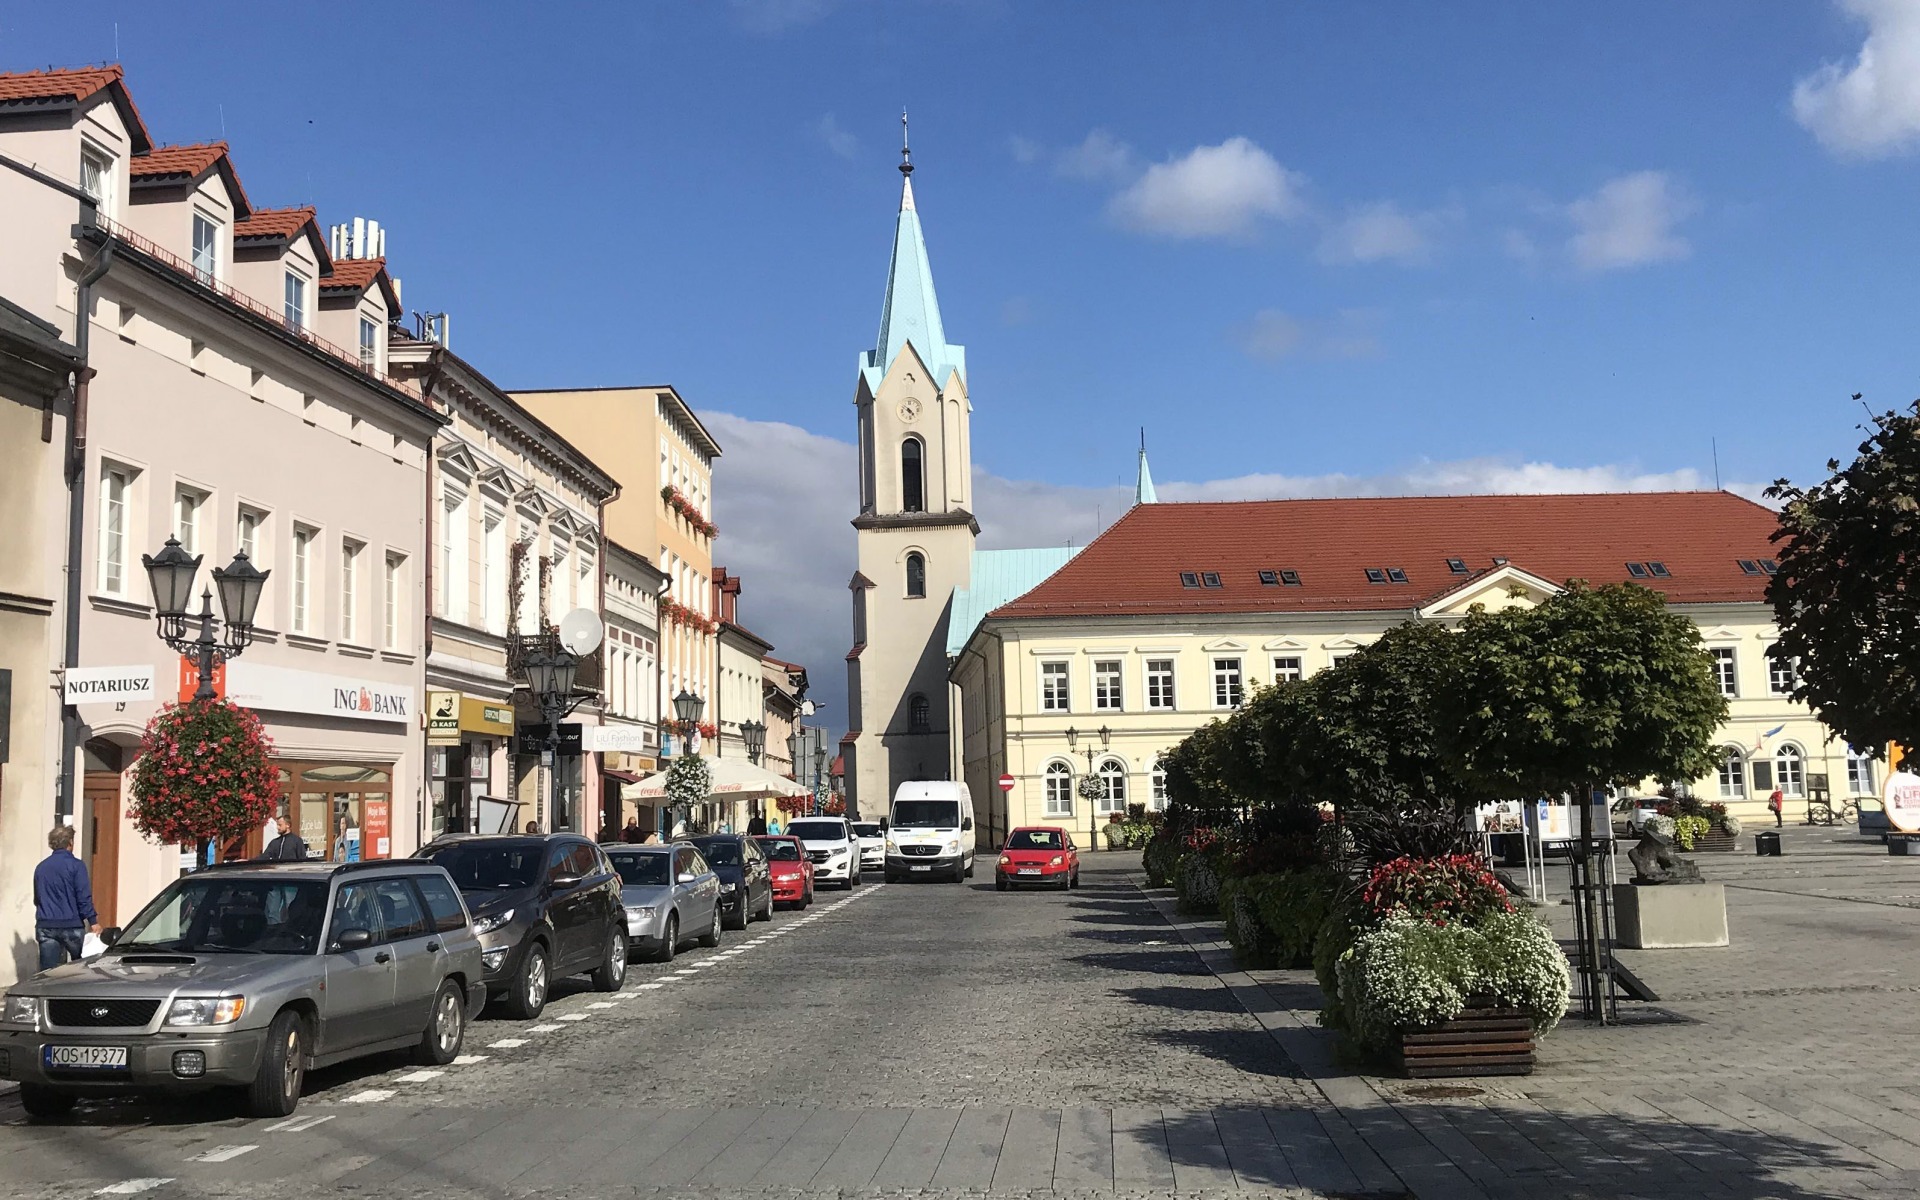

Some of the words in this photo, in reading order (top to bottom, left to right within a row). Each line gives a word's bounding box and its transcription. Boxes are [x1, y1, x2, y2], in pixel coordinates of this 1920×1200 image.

[68, 678, 150, 694] NOTARIUSZ
[115, 702, 126, 712] 19
[334, 688, 357, 711] ING
[374, 693, 407, 716] BANK
[611, 734, 640, 743] Fashion
[1903, 790, 1920, 799] LIF
[53, 1047, 79, 1063] KOS
[84, 1048, 125, 1064] 19377
